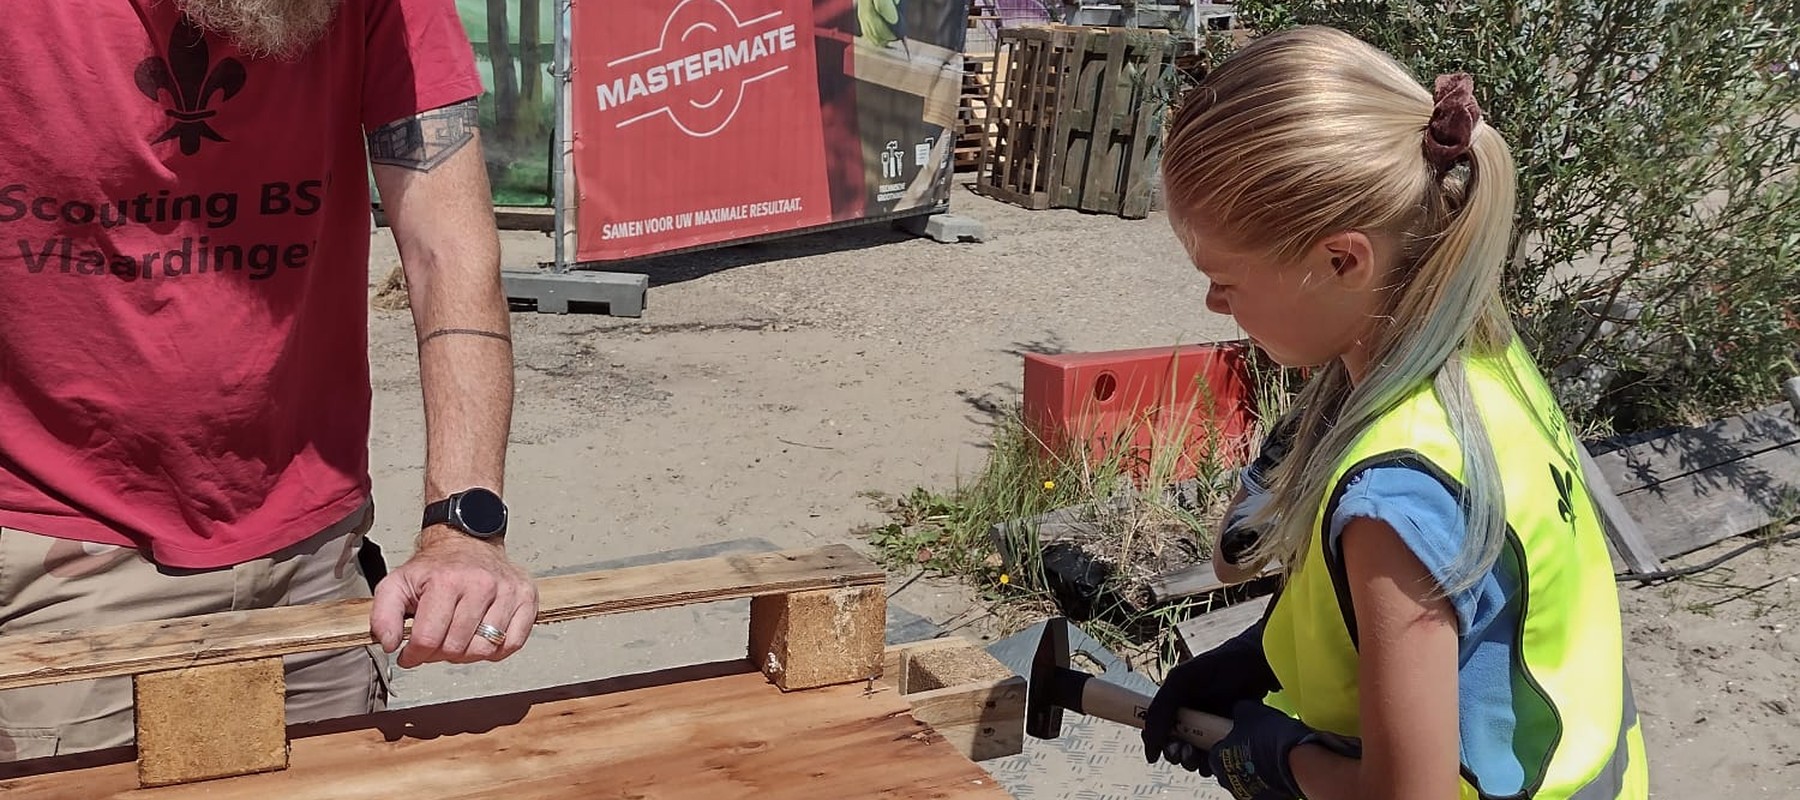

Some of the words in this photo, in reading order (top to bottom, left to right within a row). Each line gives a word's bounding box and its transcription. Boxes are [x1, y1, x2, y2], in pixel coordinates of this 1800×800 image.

[596, 24, 797, 111] MASTERMATE
[0, 183, 239, 229] Scouting
[601, 219, 643, 240] SAMEN
[645, 215, 674, 235] VOOR
[675, 213, 693, 230] UW
[695, 204, 748, 225] MAXIMALE
[749, 197, 803, 218] RESULTAAT.
[17, 236, 318, 281] Vlaardinge
